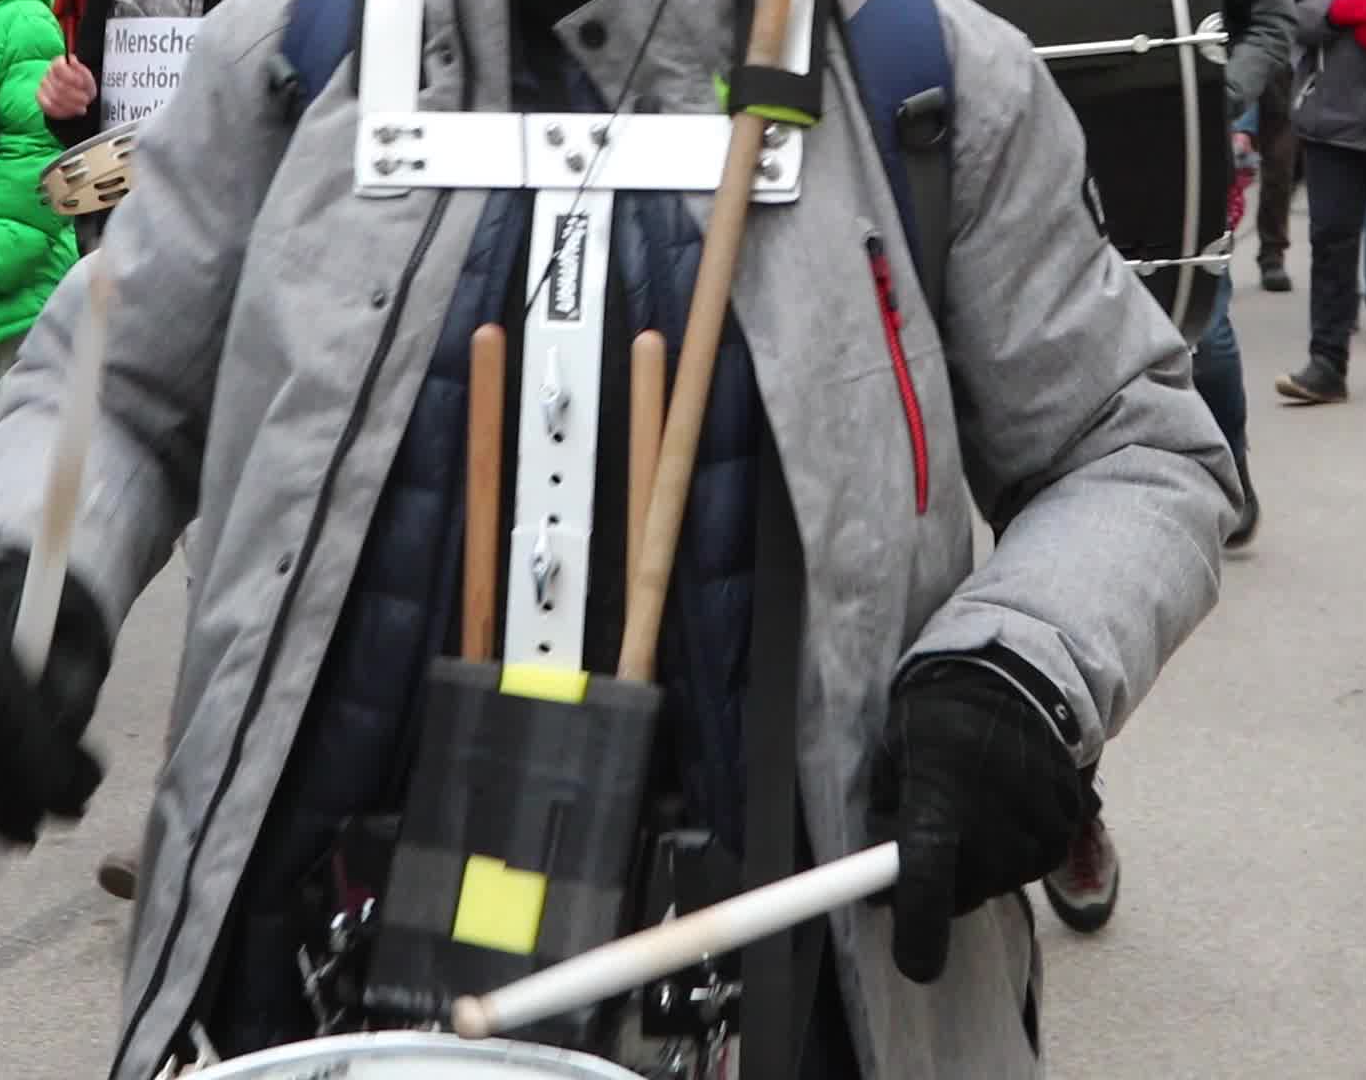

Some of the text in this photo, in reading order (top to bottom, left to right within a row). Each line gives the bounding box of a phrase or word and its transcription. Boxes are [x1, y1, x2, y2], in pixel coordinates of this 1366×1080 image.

[131, 64, 180, 88] schön
[106, 98, 164, 121] elt wo
